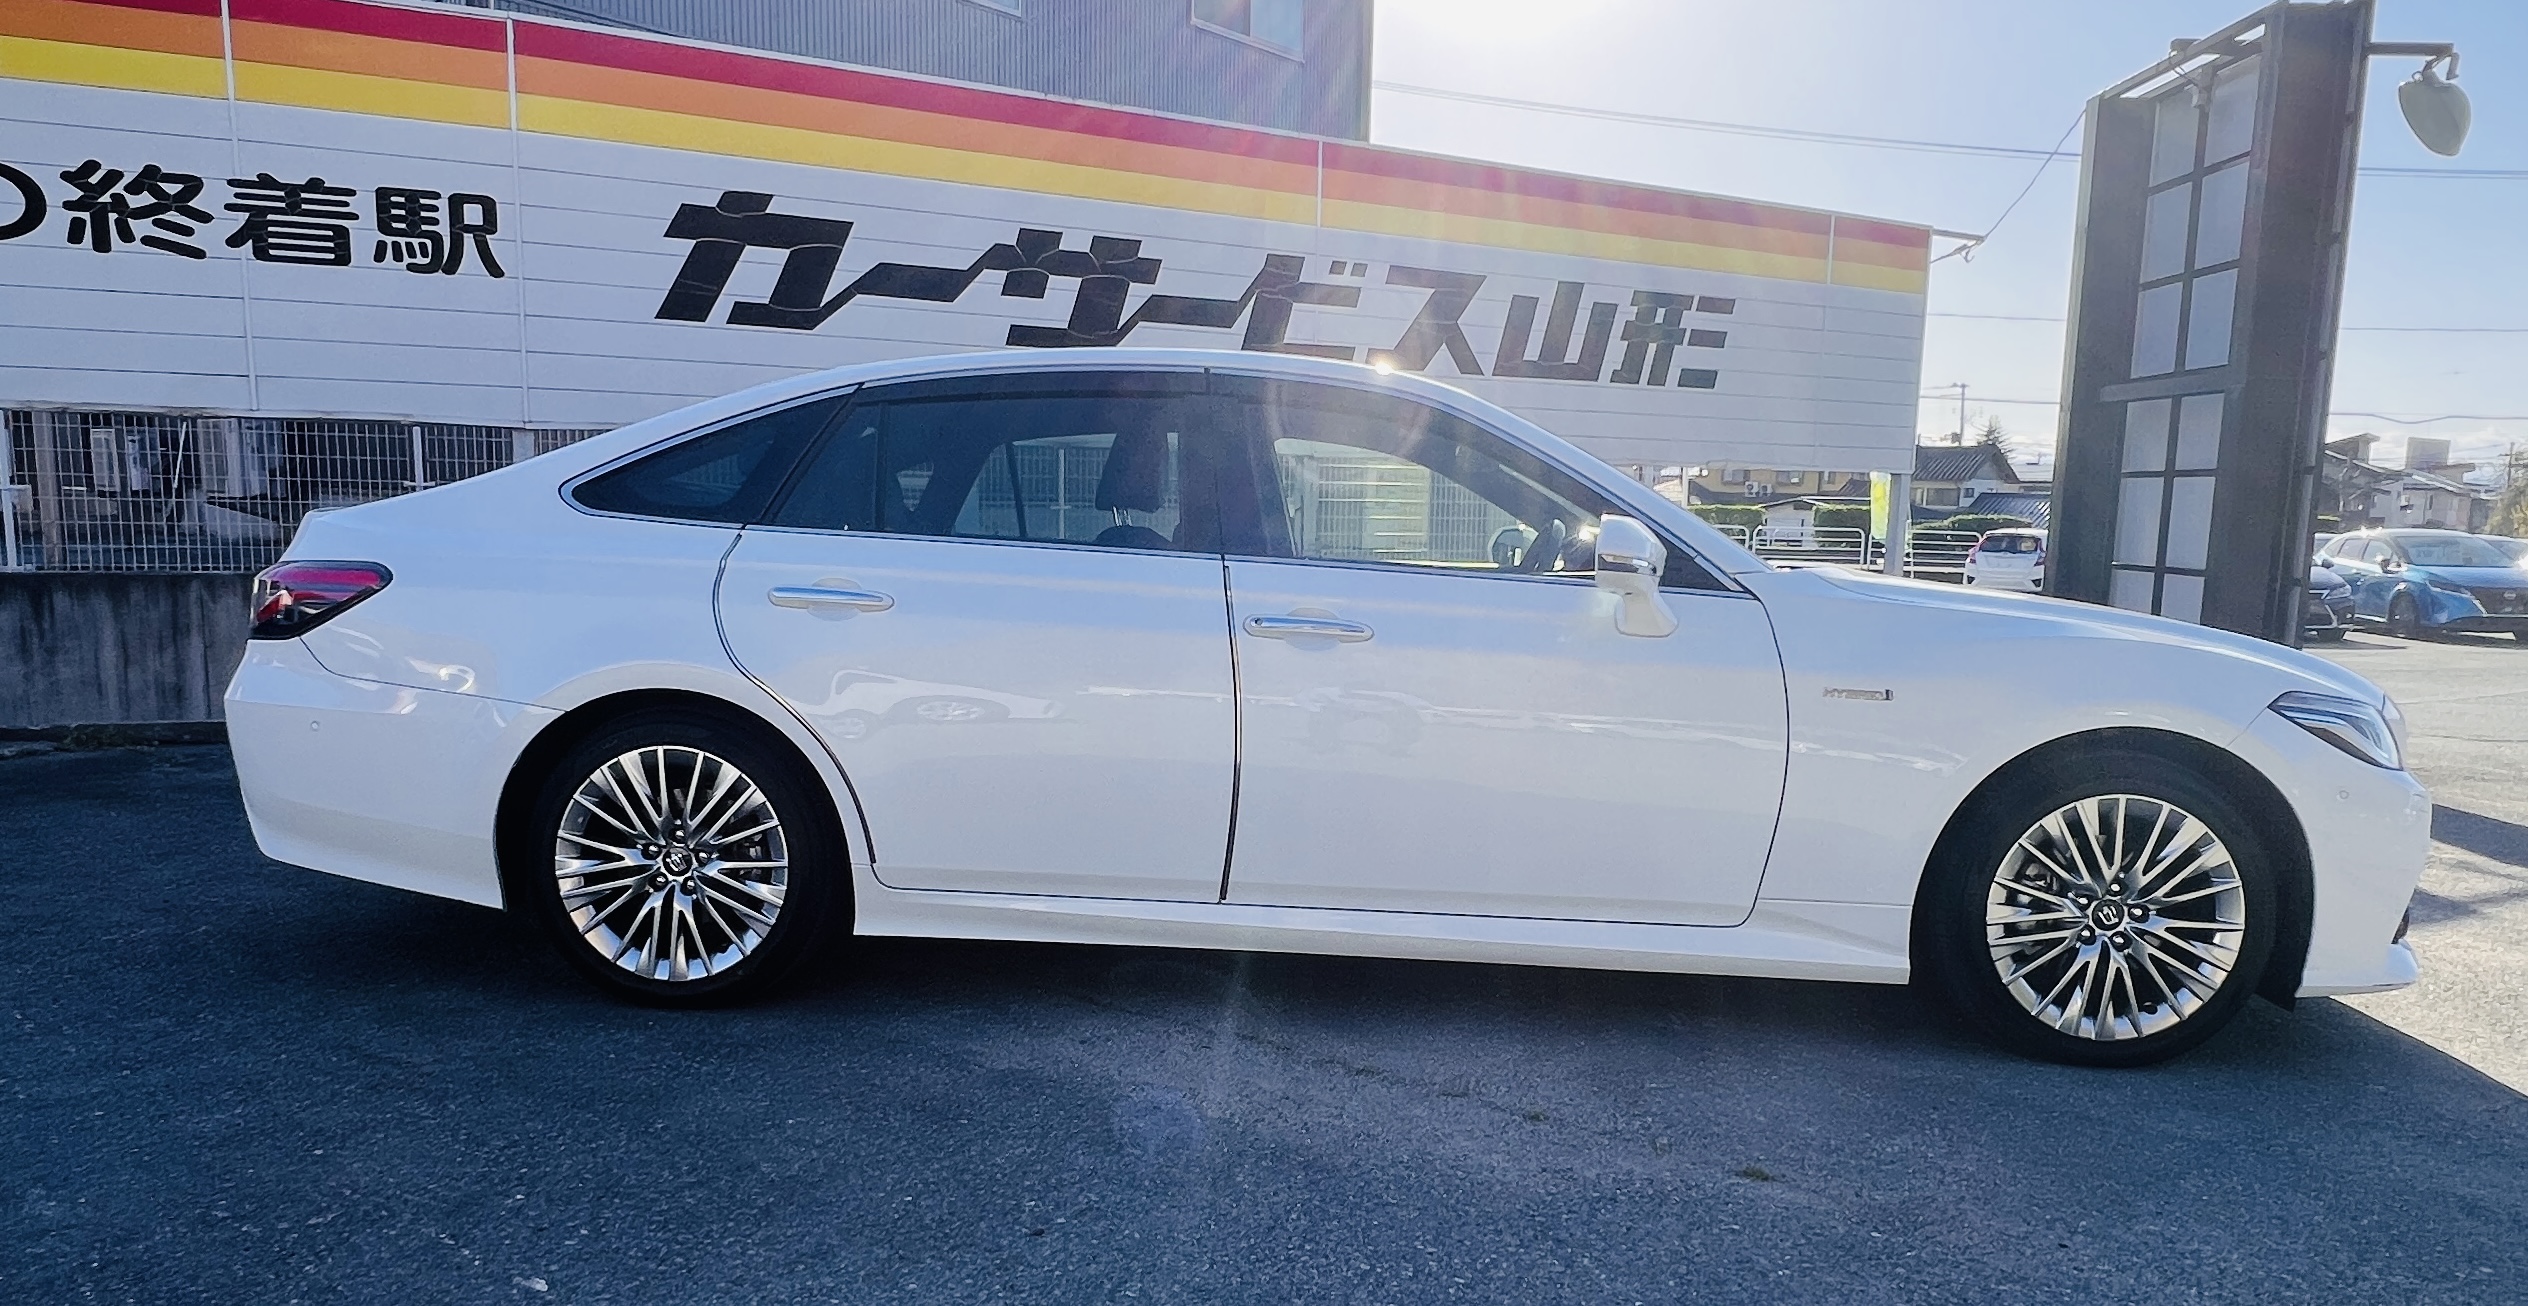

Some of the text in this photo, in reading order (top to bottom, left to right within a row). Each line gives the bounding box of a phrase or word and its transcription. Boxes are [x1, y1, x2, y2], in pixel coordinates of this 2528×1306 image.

[655, 190, 1736, 389] カーサービス山形
